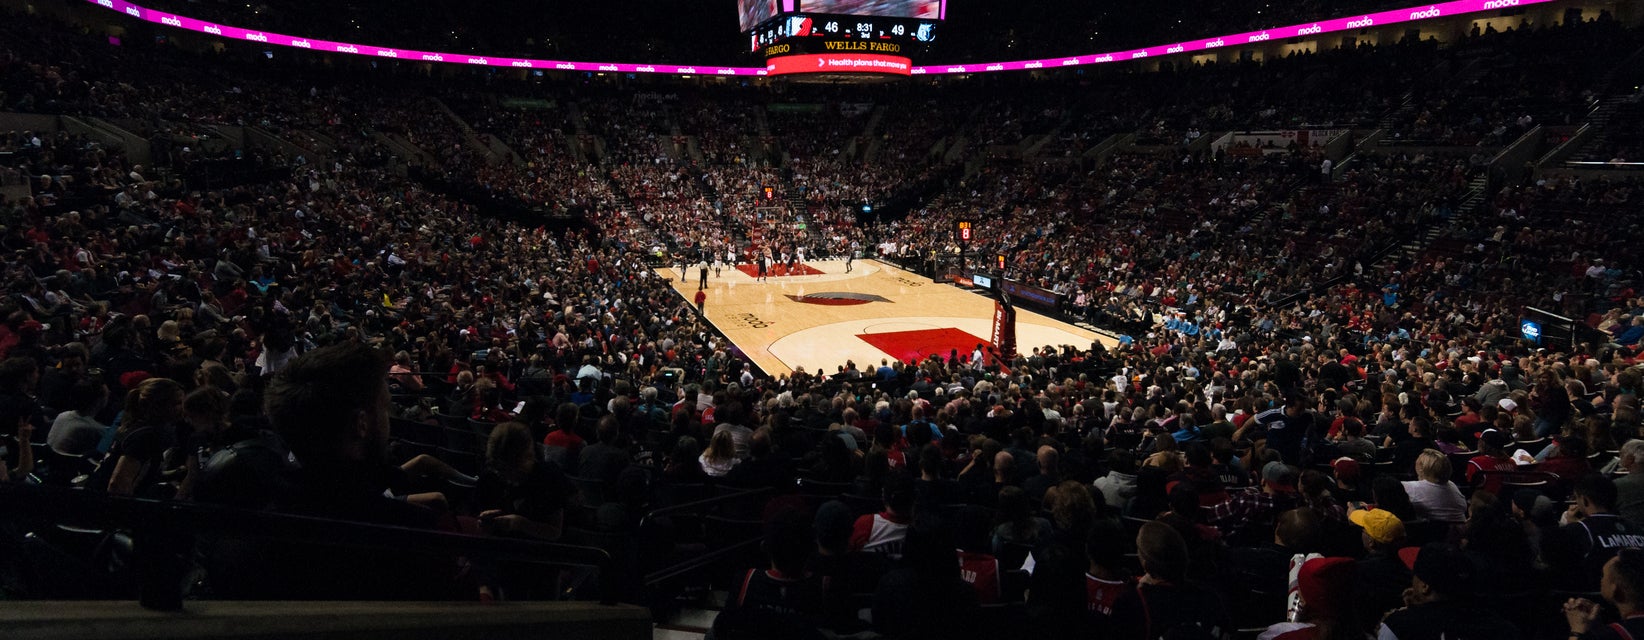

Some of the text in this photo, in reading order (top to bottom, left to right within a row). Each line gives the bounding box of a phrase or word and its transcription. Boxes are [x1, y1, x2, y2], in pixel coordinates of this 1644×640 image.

[1410, 6, 1440, 20] moda
[162, 16, 181, 26] moda
[1347, 15, 1373, 28] moda
[204, 25, 221, 35] moda
[825, 22, 838, 33] 46
[857, 23, 873, 33] 8:31
[891, 25, 905, 36] 49
[1298, 24, 1321, 35] moda
[246, 32, 267, 42] moda
[1249, 32, 1269, 42] moda
[292, 39, 311, 48] moda
[824, 41, 900, 52] WELLS FARGO
[1206, 38, 1224, 48] moda
[337, 45, 358, 53] moda
[378, 49, 397, 57] moda
[423, 53, 443, 61] moda
[1095, 54, 1113, 62] moda
[598, 64, 618, 72] moda
[853, 59, 873, 67] plans
[986, 63, 1003, 71] moda
[963, 228, 970, 239] 8
